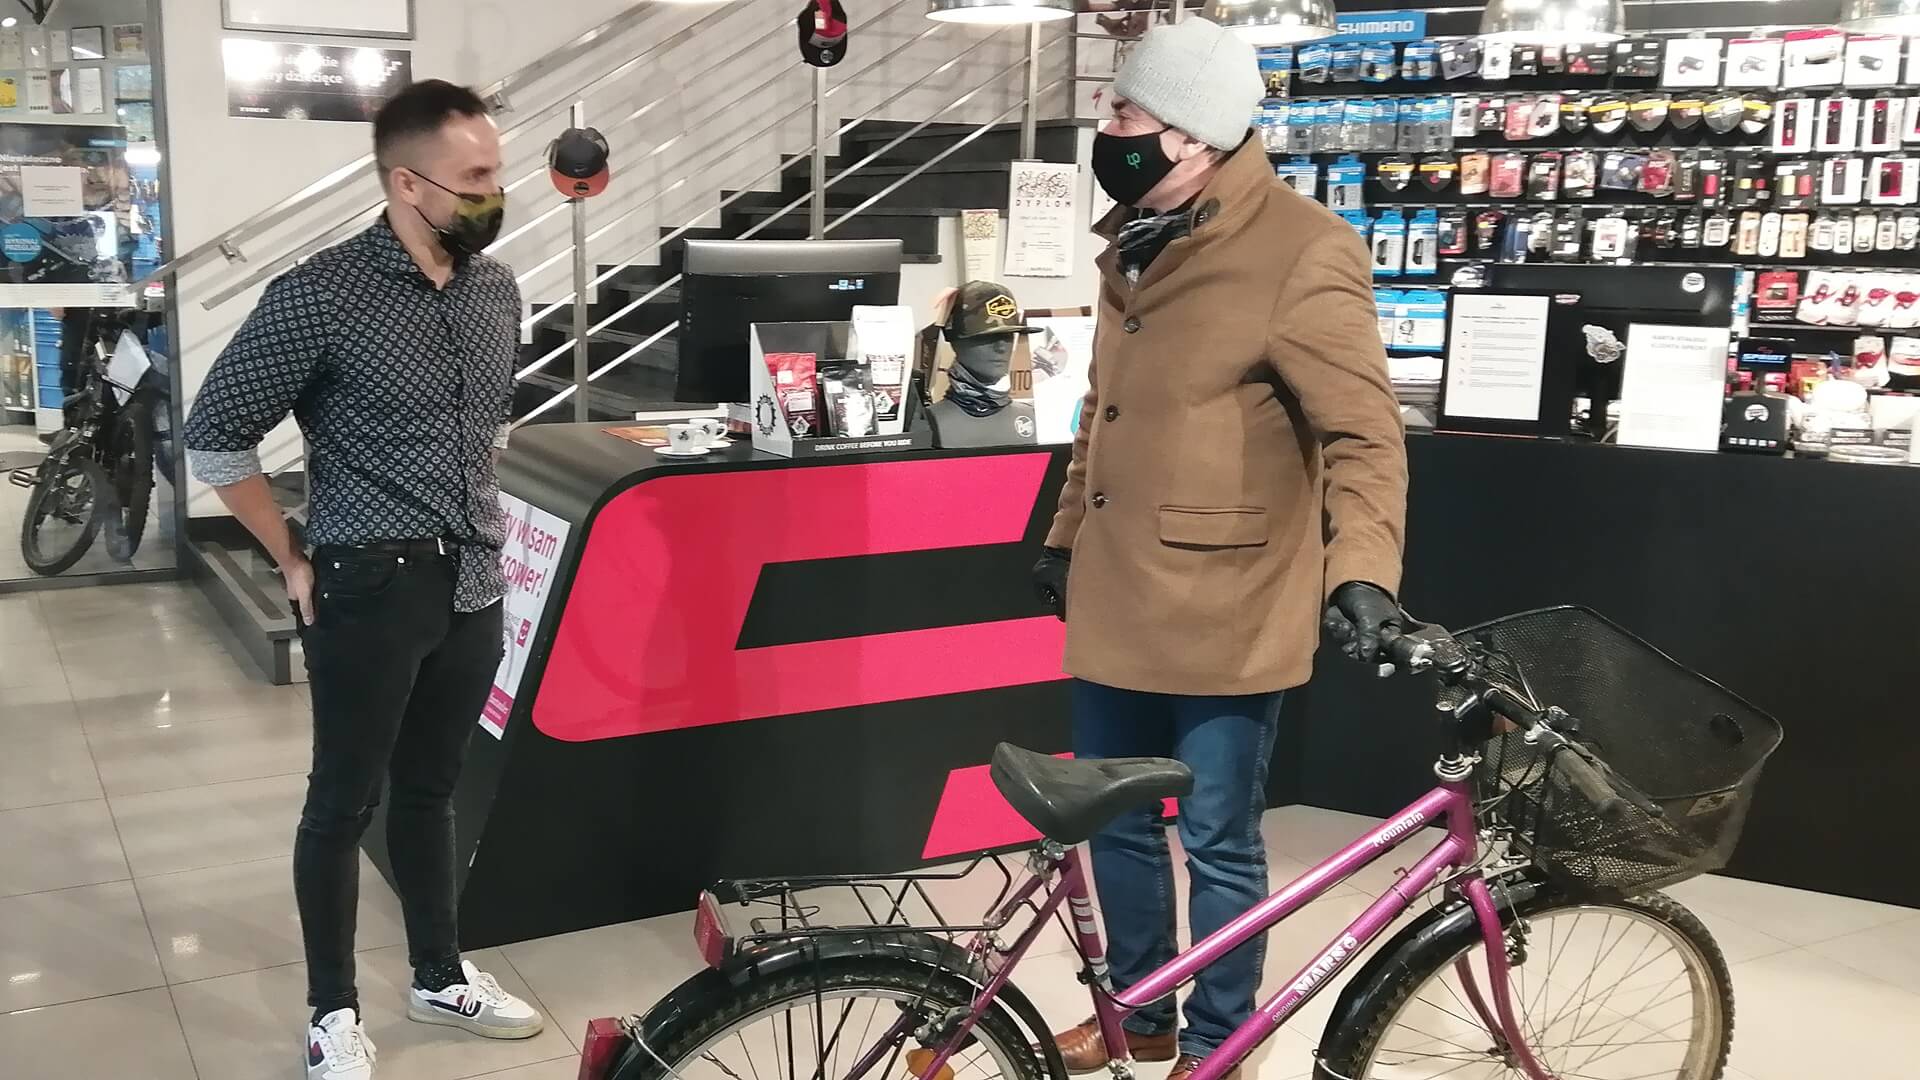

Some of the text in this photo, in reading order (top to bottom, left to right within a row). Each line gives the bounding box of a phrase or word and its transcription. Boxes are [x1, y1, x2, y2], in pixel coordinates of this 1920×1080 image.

[1337, 20, 1415, 35] SHIMANO
[1015, 199, 1072, 208] DYPLOM
[836, 442, 859, 450] COFFEE
[528, 526, 557, 561] sam
[1371, 811, 1425, 848] Mountain
